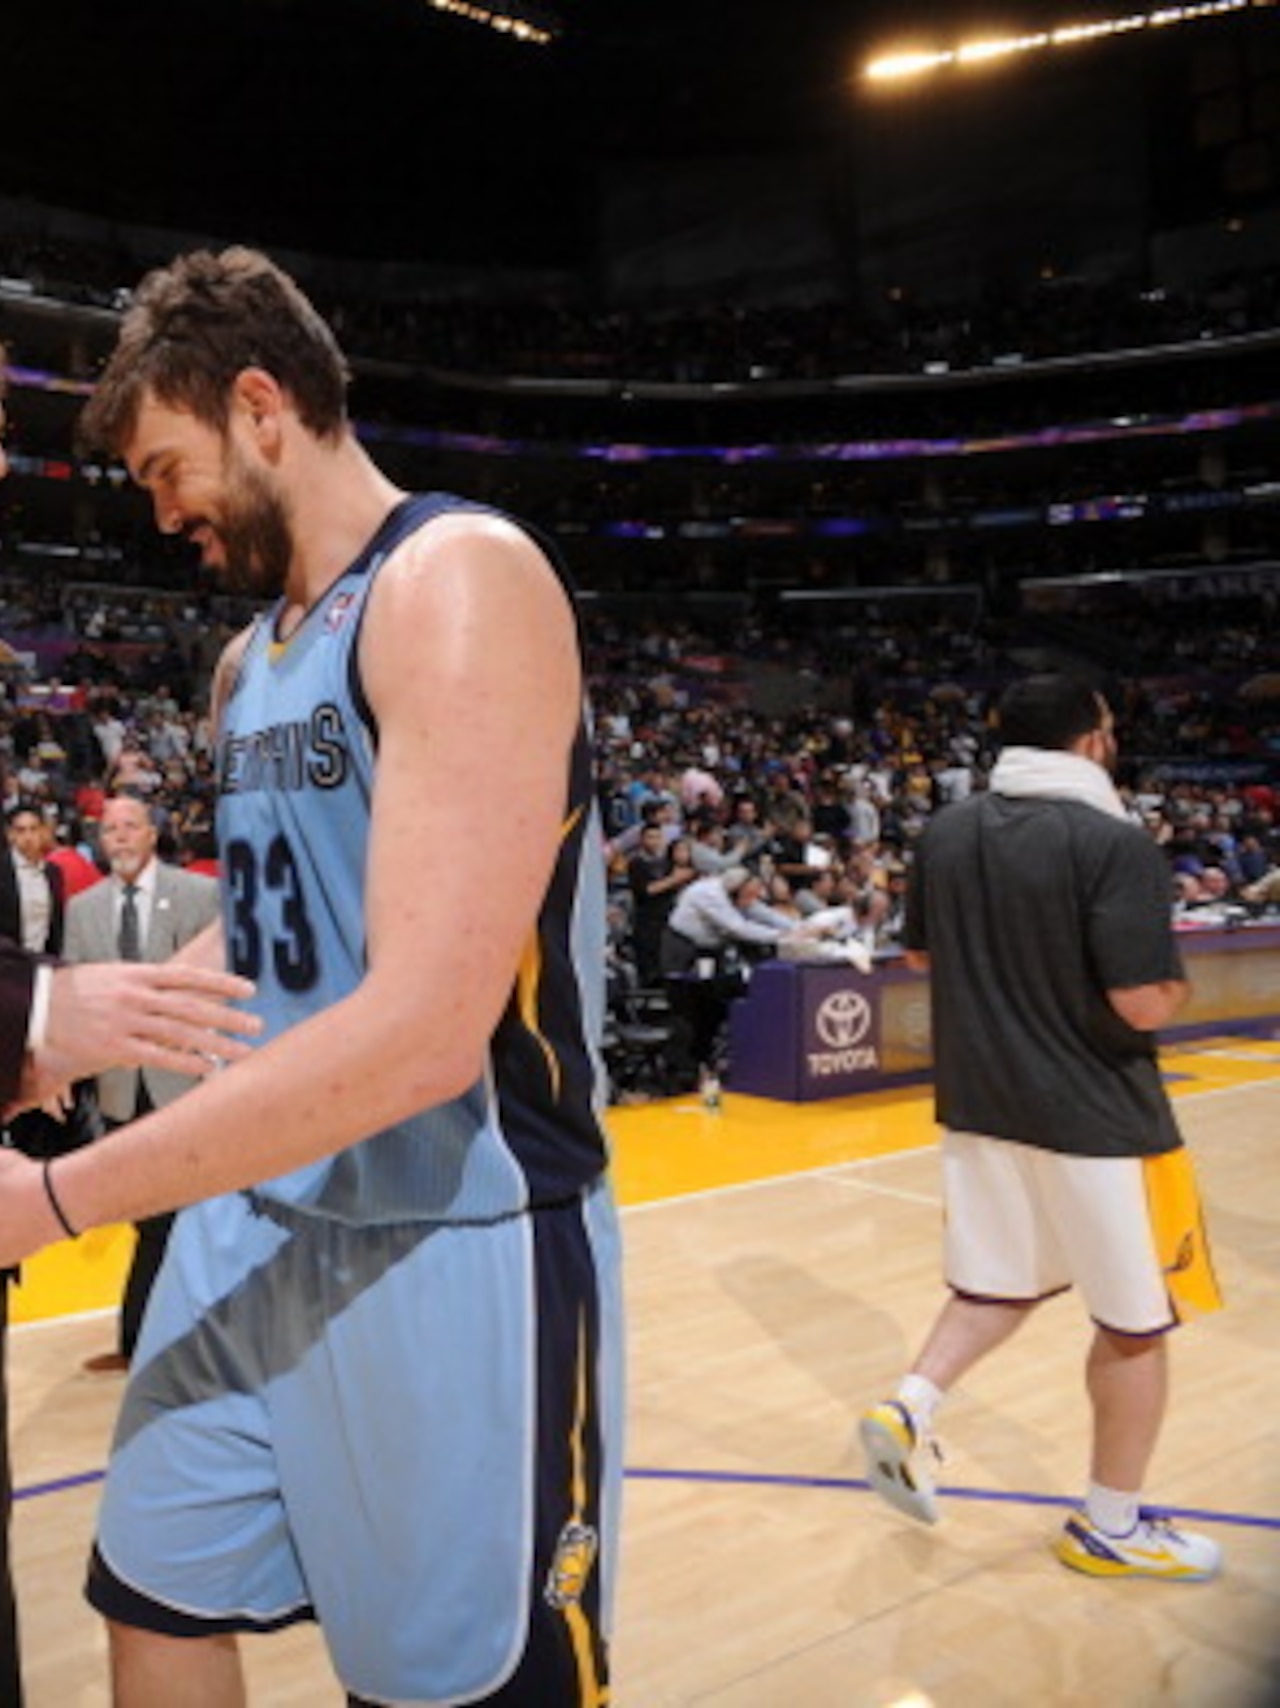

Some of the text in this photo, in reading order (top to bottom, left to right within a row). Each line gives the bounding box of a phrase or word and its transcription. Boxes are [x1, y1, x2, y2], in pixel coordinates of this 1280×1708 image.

[215, 702, 347, 795] EMPHIS
[226, 832, 319, 992] 33
[807, 1047, 879, 1077] TOYOTA
